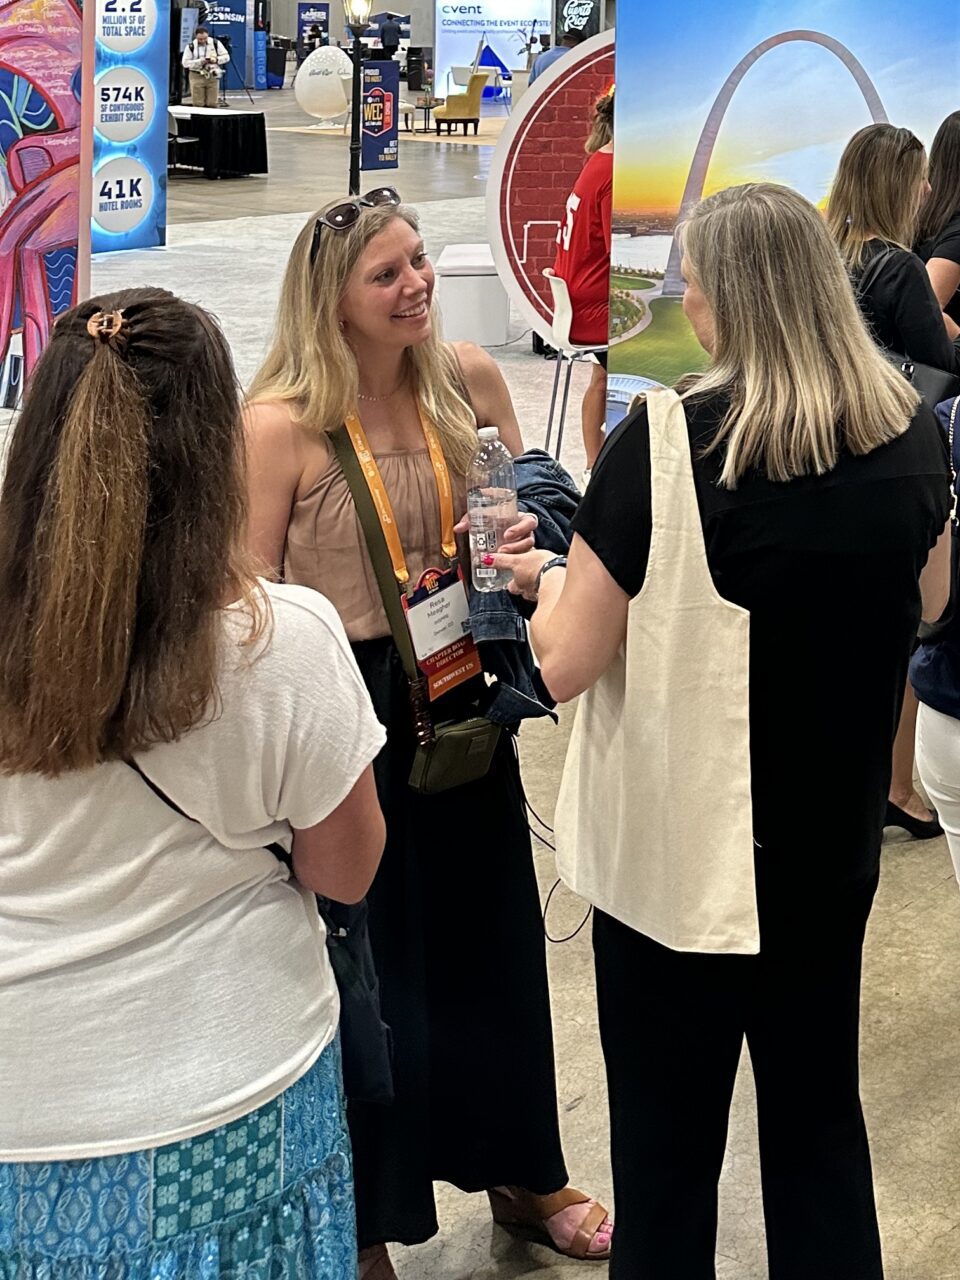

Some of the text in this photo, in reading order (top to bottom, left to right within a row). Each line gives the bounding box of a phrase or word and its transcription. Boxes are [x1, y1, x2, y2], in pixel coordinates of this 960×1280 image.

[442, 5, 482, 14] cvent
[563, 0, 594, 17] Puerto
[102, 16, 146, 25] MILLION SF OF
[564, 15, 589, 32] Rico
[102, 26, 146, 36] TOTAL SPACE
[101, 86, 144, 102] 574K
[100, 104, 108, 112] SF
[364, 104, 383, 121] WEC
[100, 112, 144, 122] EXHIBIT SPACE
[99, 178, 142, 199] 41K
[99, 199, 142, 212] HOTEL ROOMS
[426, 647, 451, 666] CHAPTER
[436, 648, 465, 668] DIRECTOR
